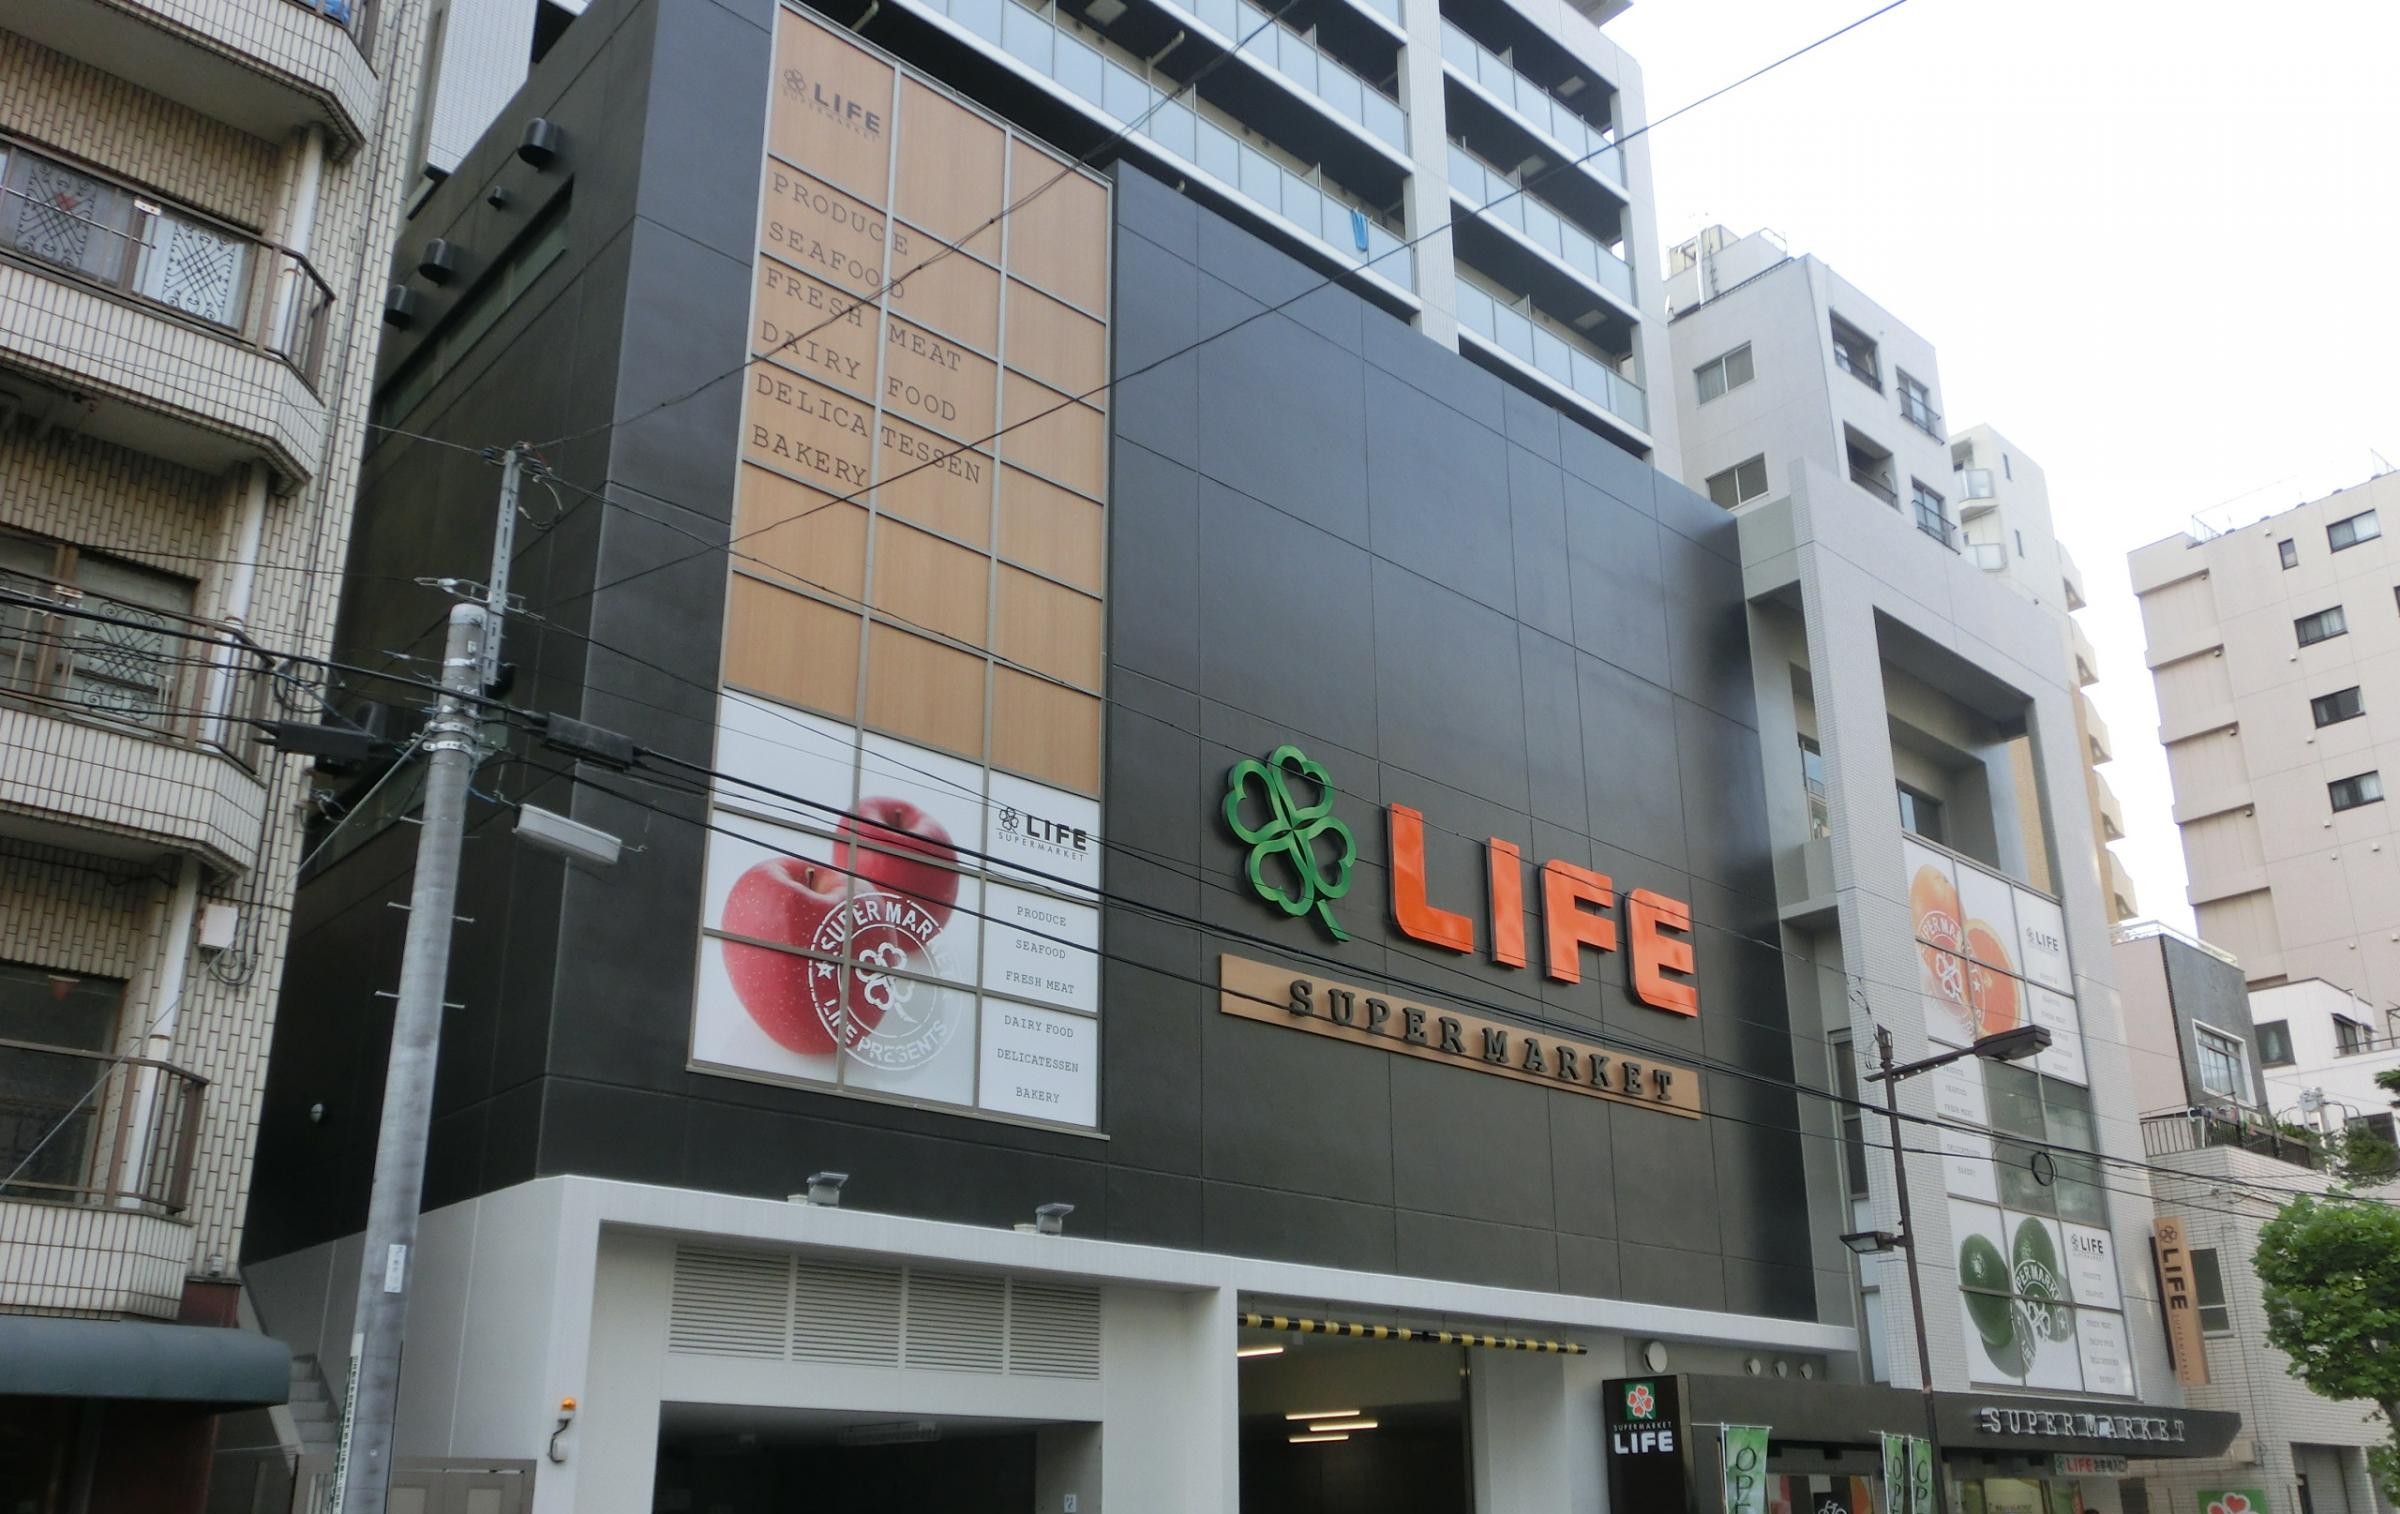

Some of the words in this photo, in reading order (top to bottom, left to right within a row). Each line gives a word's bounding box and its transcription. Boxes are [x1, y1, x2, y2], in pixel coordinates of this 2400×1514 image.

[814, 82, 881, 135] LIFE
[772, 172, 908, 255] PRODUCE
[768, 221, 905, 300] SEAFOOD
[765, 267, 864, 328] FRESH
[888, 323, 961, 372] MEAT
[760, 320, 862, 380] DAIRY
[887, 375, 957, 422] FOOD
[751, 424, 867, 488] BAKERY
[998, 831, 1084, 862] SUPERMARKET
[1026, 815, 1087, 851] LIFE
[1016, 906, 1067, 927] PRODUCE
[1388, 802, 1698, 1018] LIFE
[1015, 939, 1066, 960] SEAFOOD
[2035, 931, 2059, 952] LIFE
[1005, 971, 1041, 989] FRESH
[1045, 978, 1075, 995] MEAT
[857, 1019, 948, 1063] PRESENTS
[1004, 1015, 1043, 1032] DAIRY
[1045, 1022, 1074, 1038] FOOD
[1289, 978, 1674, 1102] SUPERMARKET
[996, 1048, 1079, 1073] DELICATESSEN
[1015, 1086, 1060, 1104] BAKERY
[2080, 1236, 2104, 1254] LIFE
[2162, 1248, 2189, 1309] LIFE
[1613, 1421, 1672, 1432] SUPERMARKET
[1983, 1407, 2185, 1442] SUPERMARKET
[1614, 1430, 1674, 1455] LIFE
